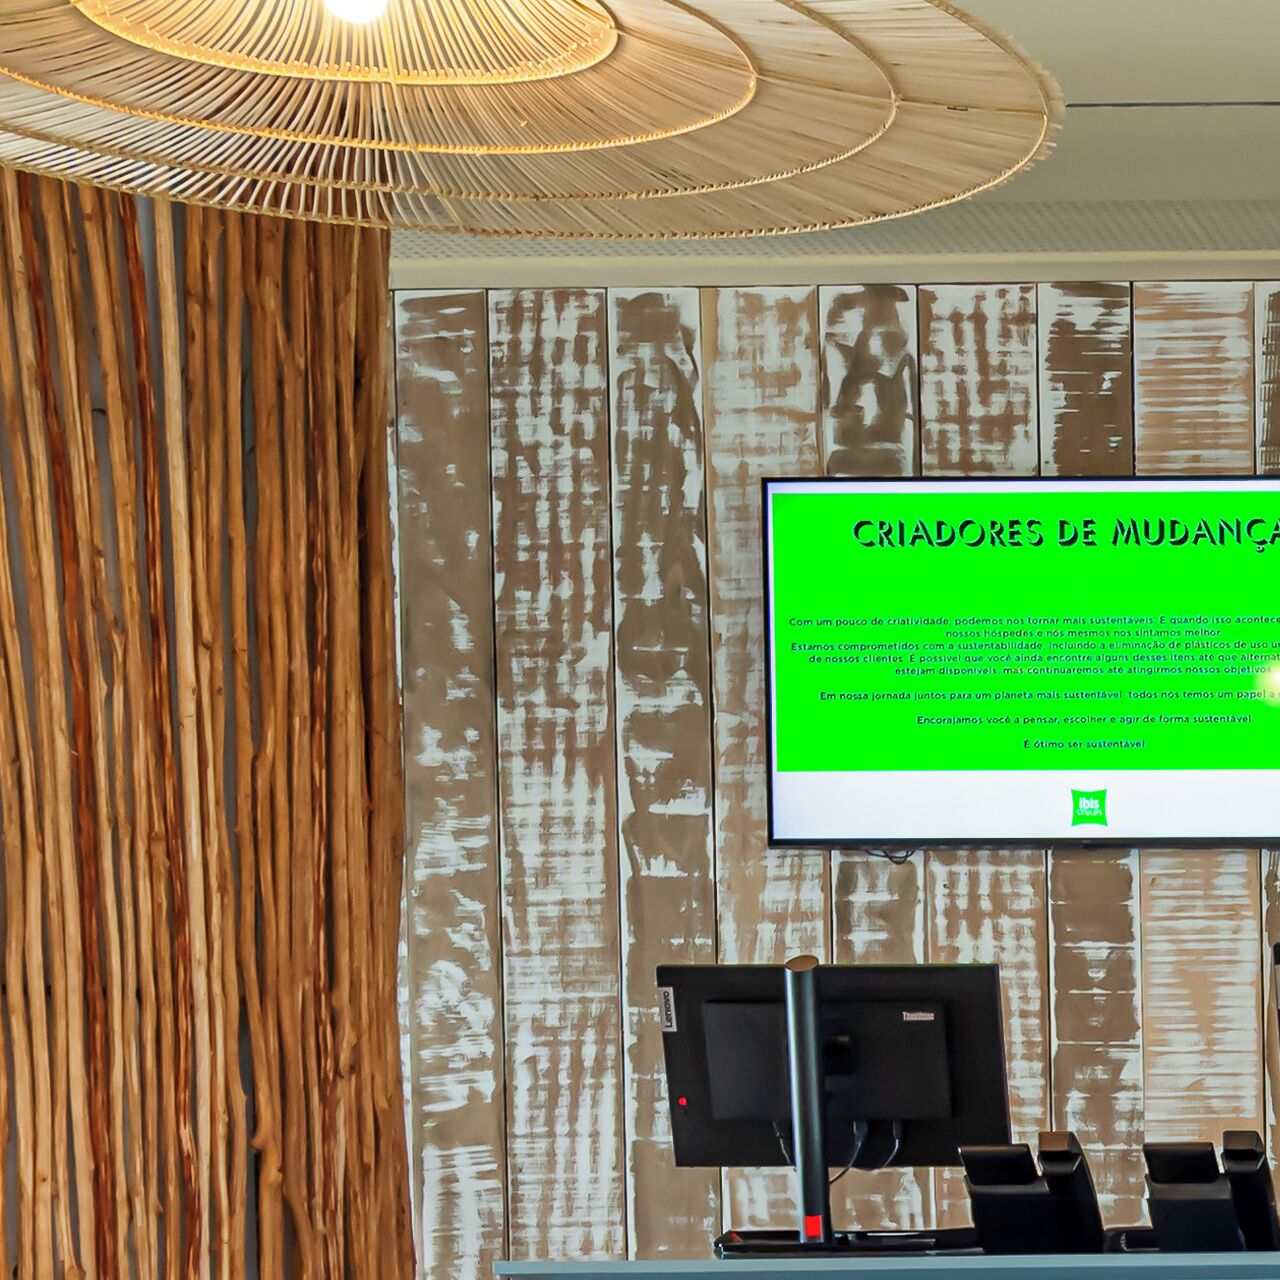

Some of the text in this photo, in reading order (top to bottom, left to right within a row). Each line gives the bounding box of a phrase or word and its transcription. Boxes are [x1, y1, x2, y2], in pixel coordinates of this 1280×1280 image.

[853, 519, 1044, 548] CRIADORES
[1058, 518, 1098, 547] DE
[788, 617, 813, 625] Com
[835, 618, 868, 627] pouco
[870, 616, 884, 625] de
[954, 616, 1004, 626] podemos
[1027, 616, 1060, 624] tornar
[1062, 616, 1087, 624] mais
[1169, 615, 1209, 626] quando
[1211, 615, 1231, 624] isso
[1046, 628, 1065, 637] nós
[1134, 627, 1182, 636] sintamos
[790, 641, 835, 650] Estamos
[837, 641, 920, 651] comprometidos
[1048, 640, 1097, 649] incluindo
[1108, 640, 1166, 650] eliminação
[1168, 640, 1182, 648] de
[1184, 640, 1231, 650] plásticos
[1233, 640, 1249, 648] de
[808, 654, 823, 663] de
[963, 655, 984, 664] que
[986, 653, 1012, 662] você
[1014, 653, 1044, 662] ainda
[1046, 653, 1093, 662] encontre
[1095, 653, 1129, 663] alguns
[1132, 653, 1167, 661] desses
[1170, 652, 1195, 661] itens
[1198, 652, 1215, 661] até
[1217, 654, 1238, 663] que
[894, 666, 935, 676] estejam
[1026, 665, 1104, 674] continuaremos
[1106, 665, 1124, 674] até
[1126, 665, 1183, 675] atingirmos
[819, 691, 837, 700] Em
[871, 691, 911, 701] jornada
[914, 691, 947, 701] juntos
[949, 692, 972, 701] para
[994, 690, 1034, 701] planeta
[1036, 690, 1061, 699] mais
[1128, 690, 1158, 698] todos
[1160, 690, 1180, 698] nós
[1182, 689, 1215, 698] temos
[1236, 689, 1266, 700] papel
[916, 715, 984, 725] Encorajamos
[986, 715, 1011, 723] você
[1022, 716, 1060, 725] pensar,
[1062, 714, 1107, 723] escolher
[1119, 714, 1139, 725] agir
[1142, 714, 1156, 722] de
[1158, 714, 1190, 722] forma
[1032, 739, 1065, 748] ótimo
[663, 991, 673, 1028] Lenovo
